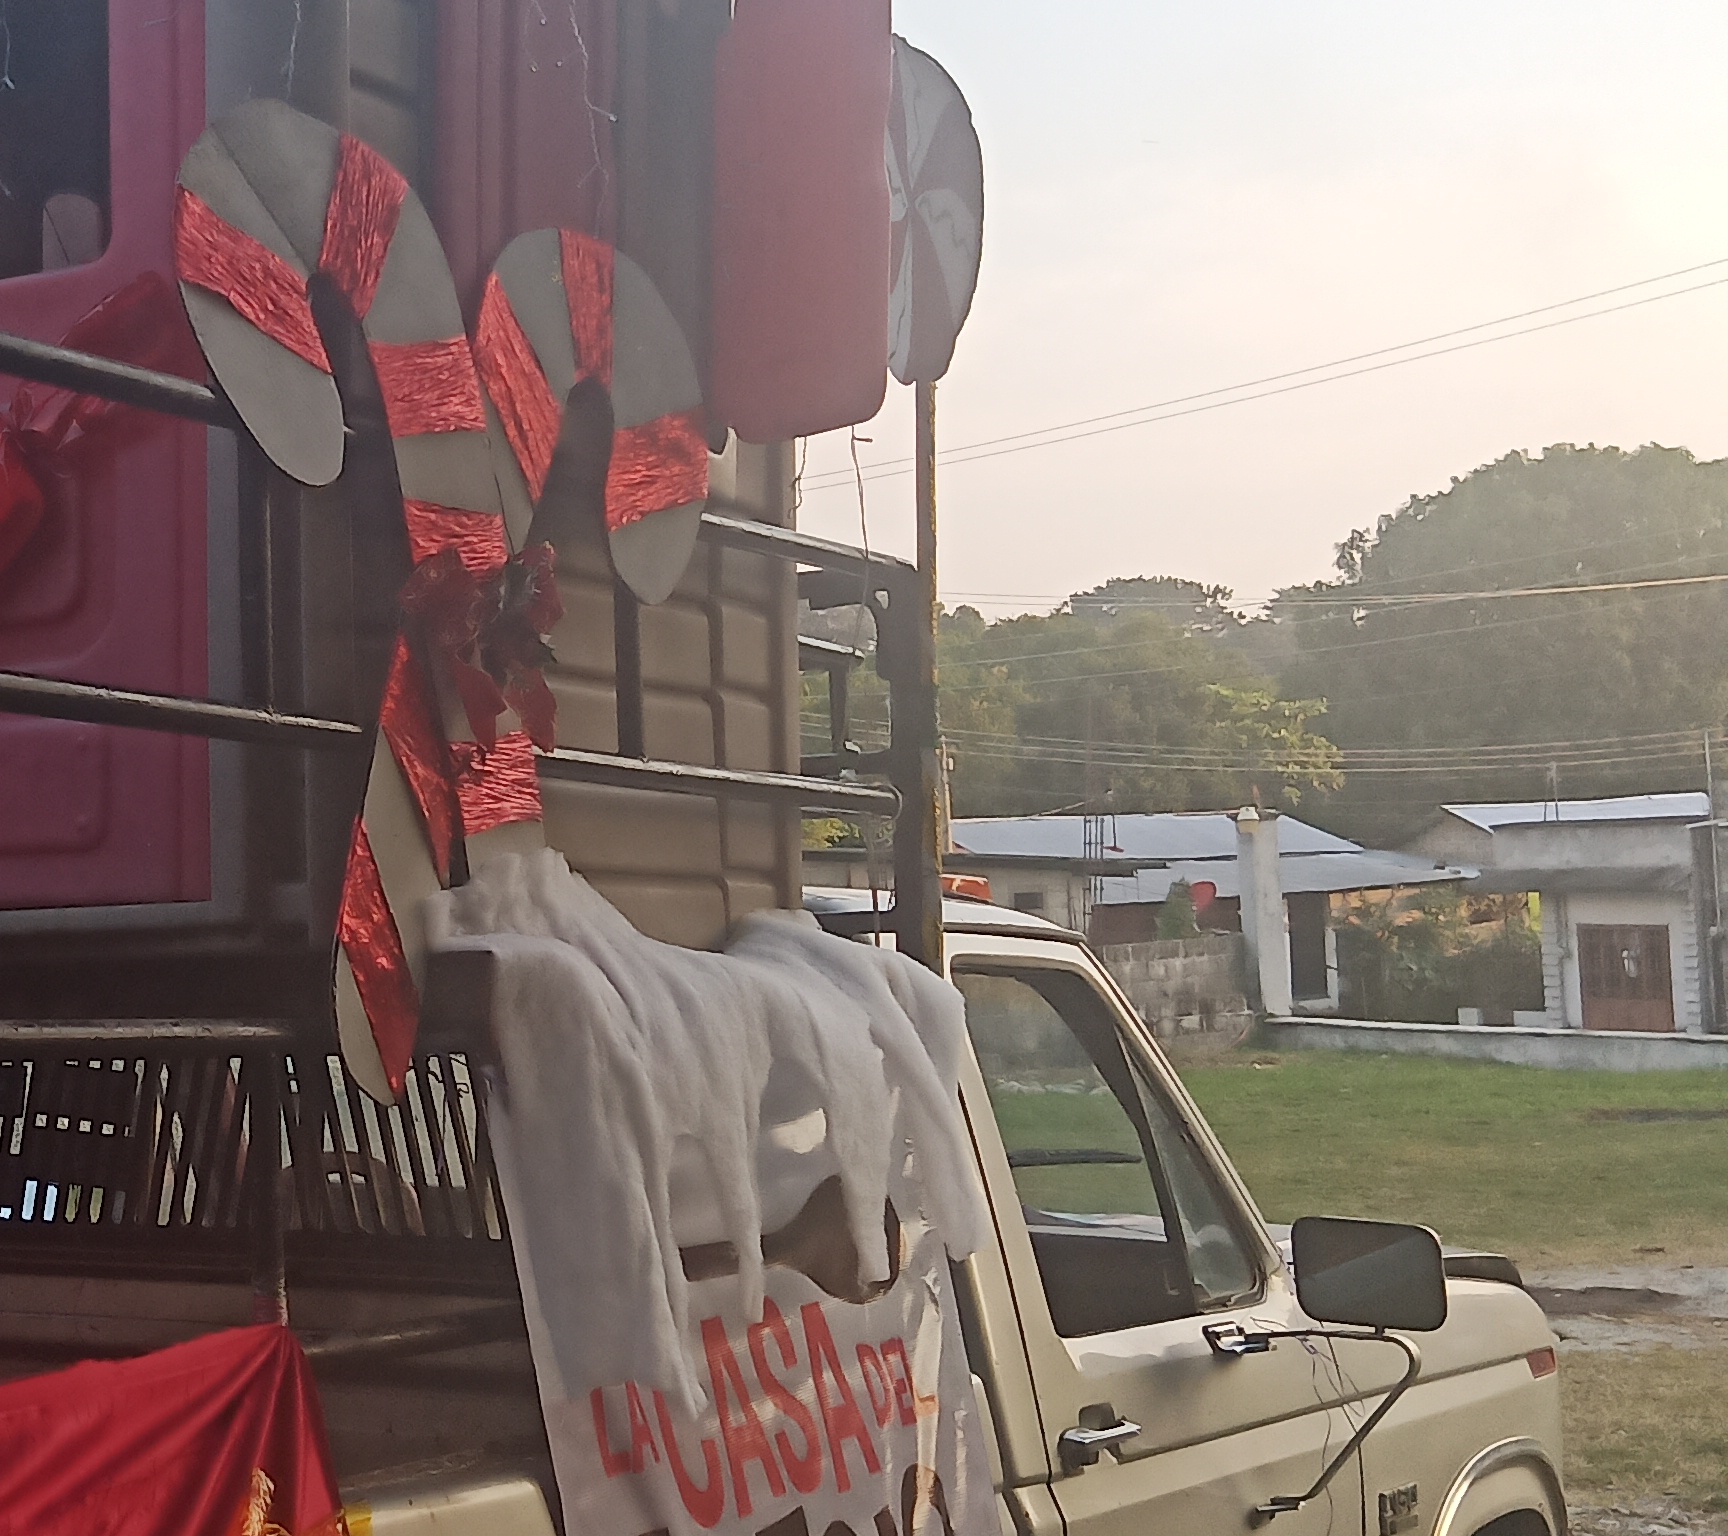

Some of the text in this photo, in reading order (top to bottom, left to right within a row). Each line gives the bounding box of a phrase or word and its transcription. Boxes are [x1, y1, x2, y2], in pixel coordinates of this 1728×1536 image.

[589, 1295, 940, 1529] LA CASA DEL
